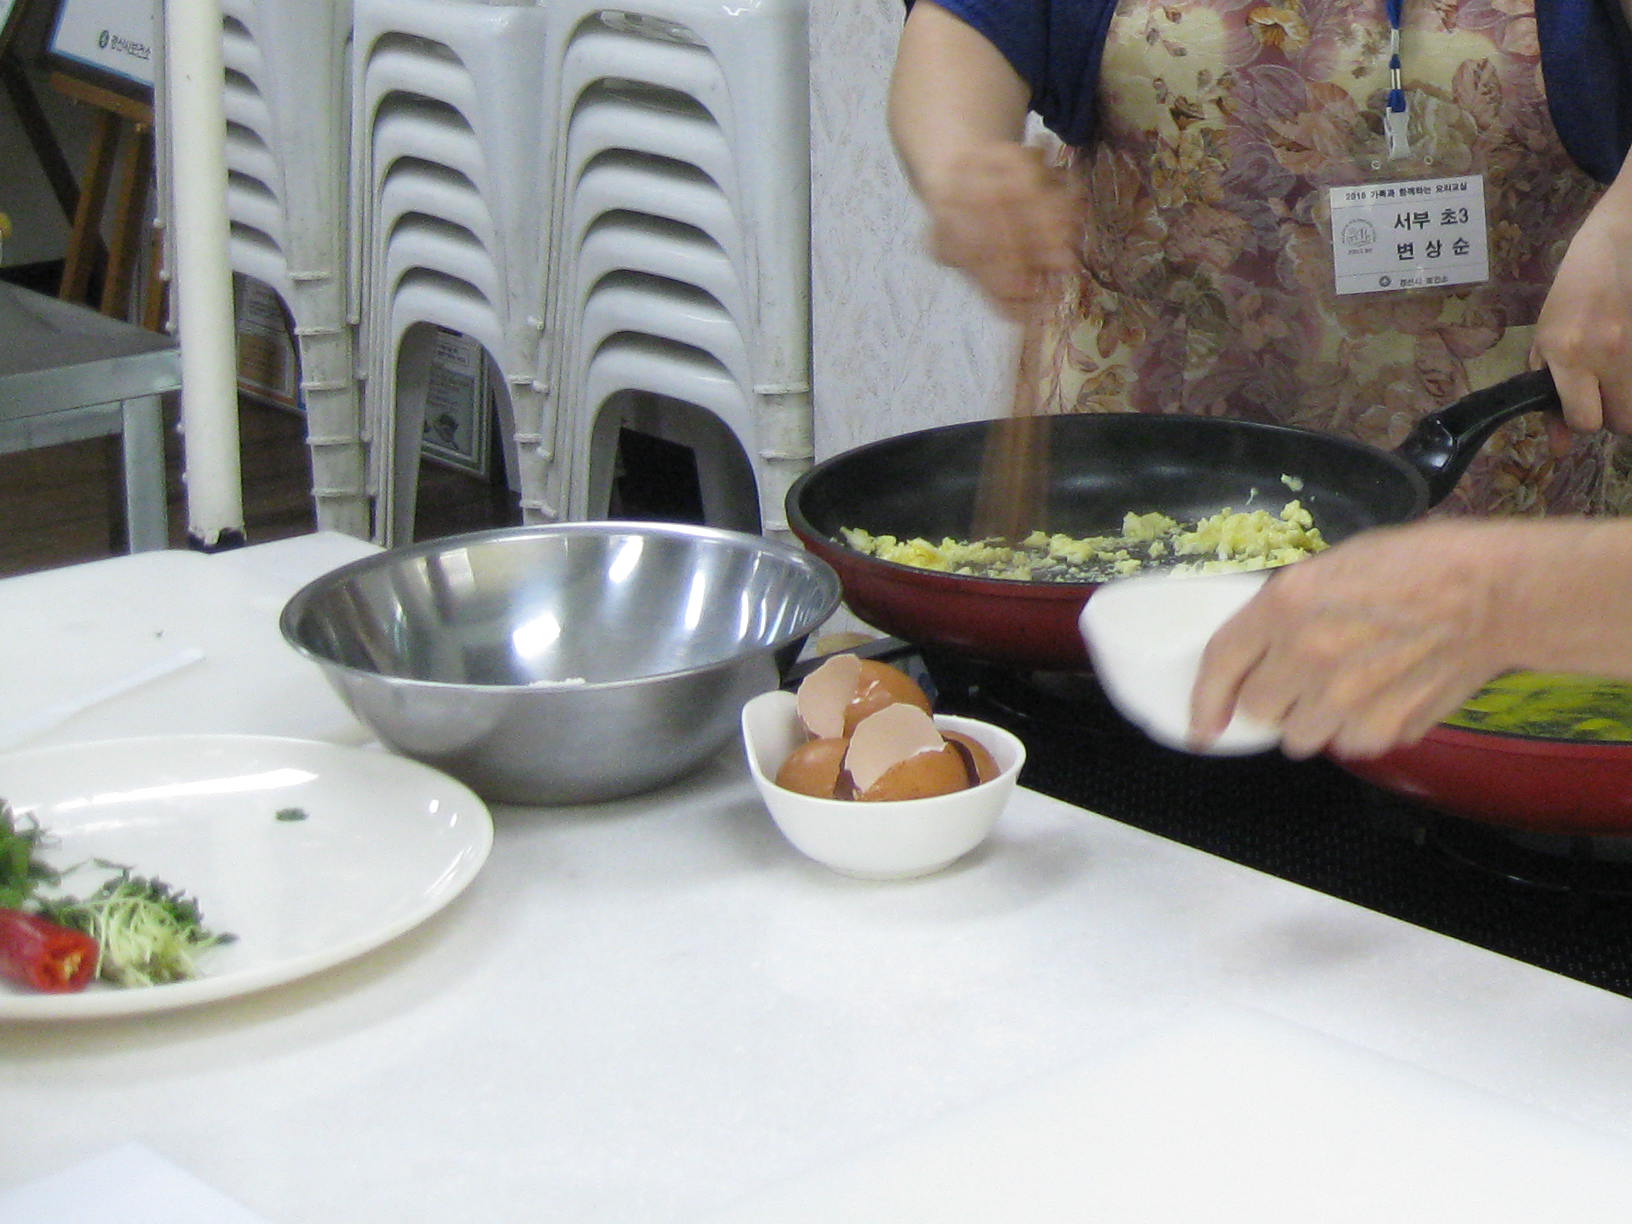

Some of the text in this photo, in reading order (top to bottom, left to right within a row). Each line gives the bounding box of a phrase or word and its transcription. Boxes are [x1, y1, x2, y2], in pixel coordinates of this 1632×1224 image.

[1370, 188, 1395, 199] 가족과
[1399, 185, 1432, 197] 함께하는
[1435, 181, 1468, 194] 요리교실
[1394, 208, 1469, 231] 서부 초3
